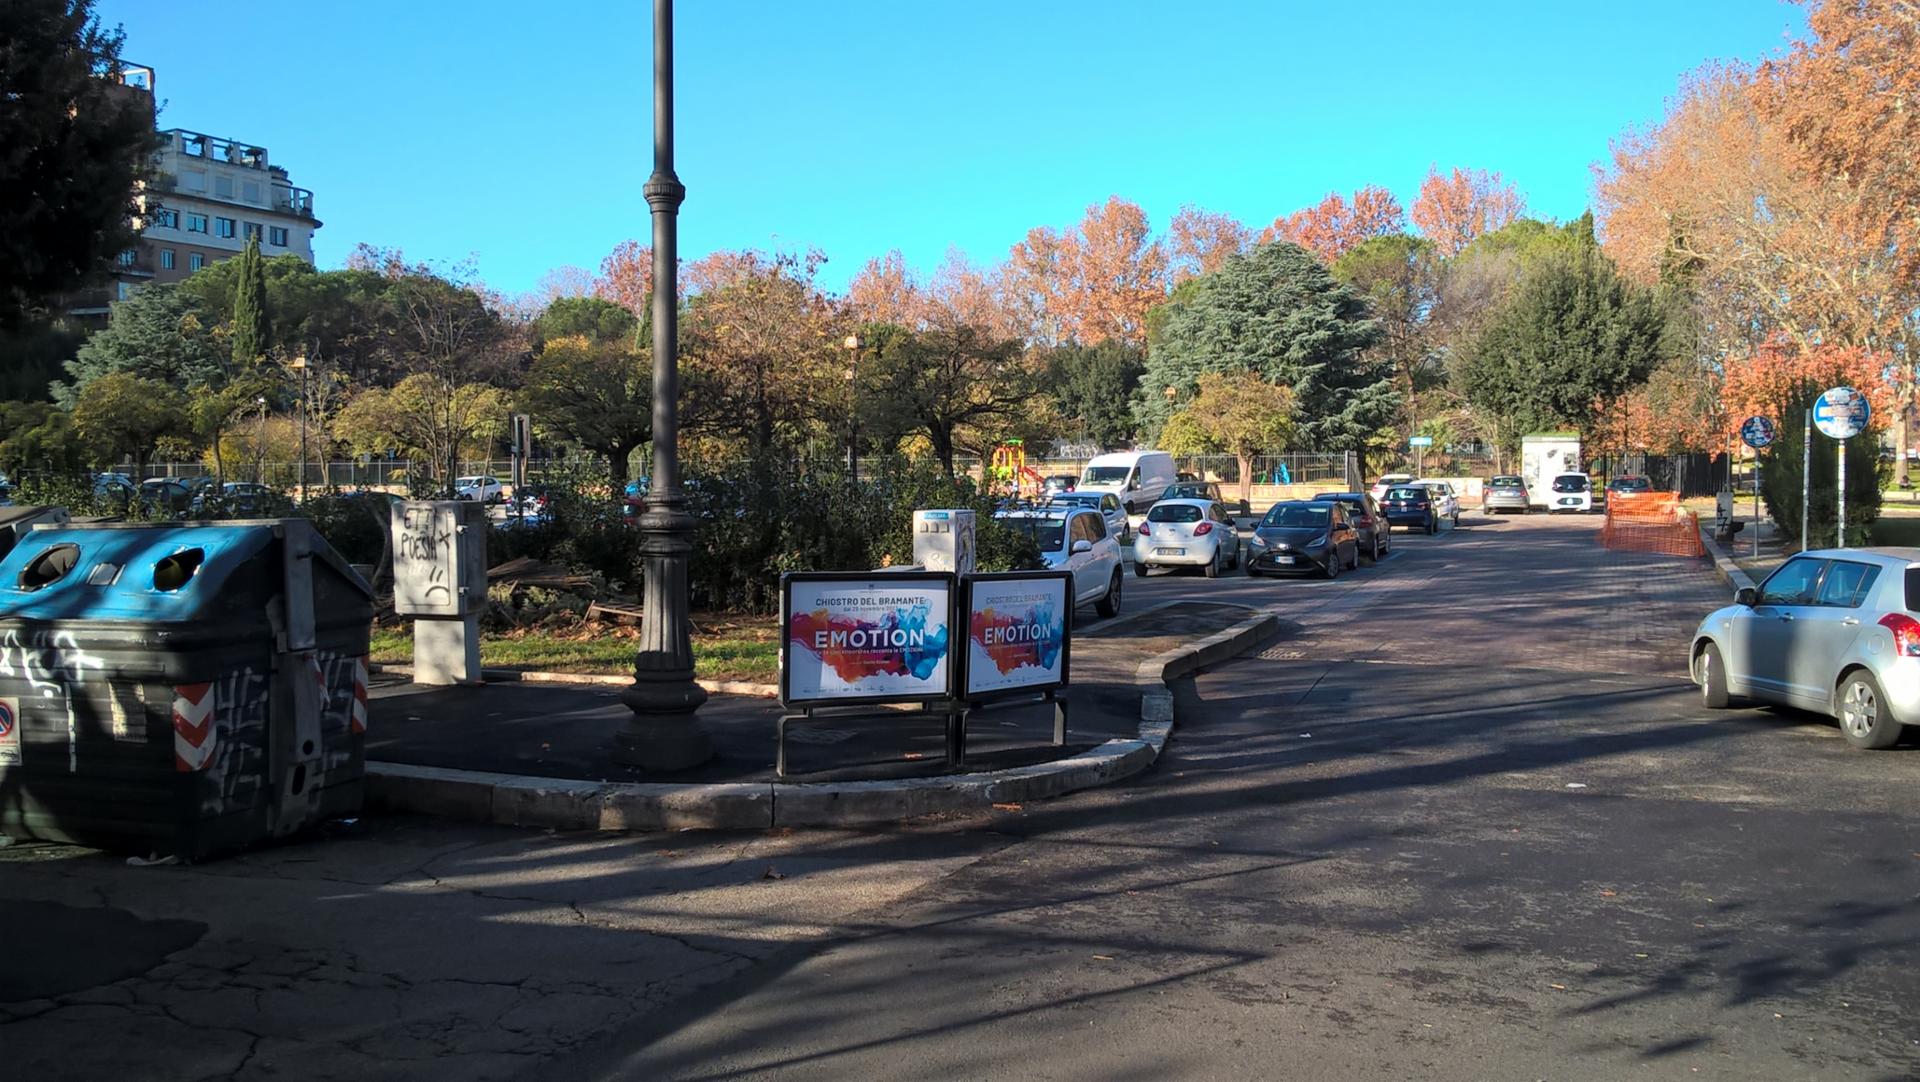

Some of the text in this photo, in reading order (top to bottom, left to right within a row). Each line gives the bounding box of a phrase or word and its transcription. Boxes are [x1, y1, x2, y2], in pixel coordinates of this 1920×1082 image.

[815, 596, 925, 606] CHIOSTRO DEL BRAMANTE
[815, 629, 924, 648] EMOTION
[984, 623, 1051, 644] EMOTION
